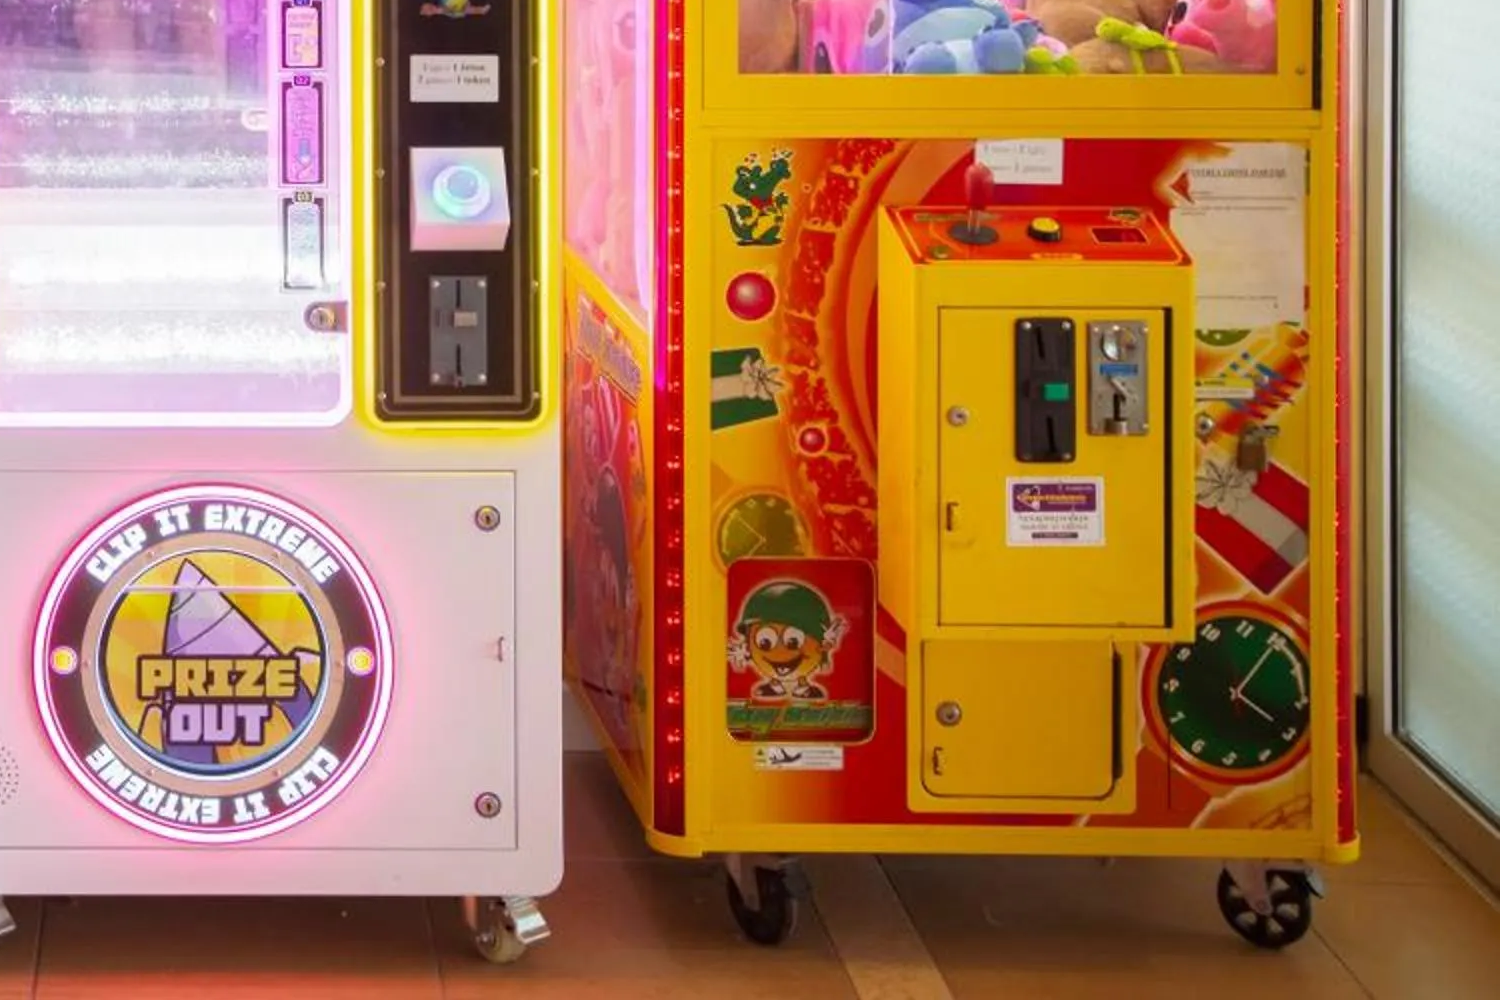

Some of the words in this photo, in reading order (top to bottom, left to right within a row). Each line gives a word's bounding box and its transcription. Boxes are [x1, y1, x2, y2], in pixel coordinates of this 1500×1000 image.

[85, 522, 147, 583] CLIP
[153, 504, 191, 537] IT
[204, 504, 341, 583] EXTREME
[138, 655, 300, 700] PRIZE
[167, 703, 271, 745] OUT
[85, 743, 220, 824] EXTREME
[277, 745, 340, 805] CLIP
[233, 790, 271, 823] IT
